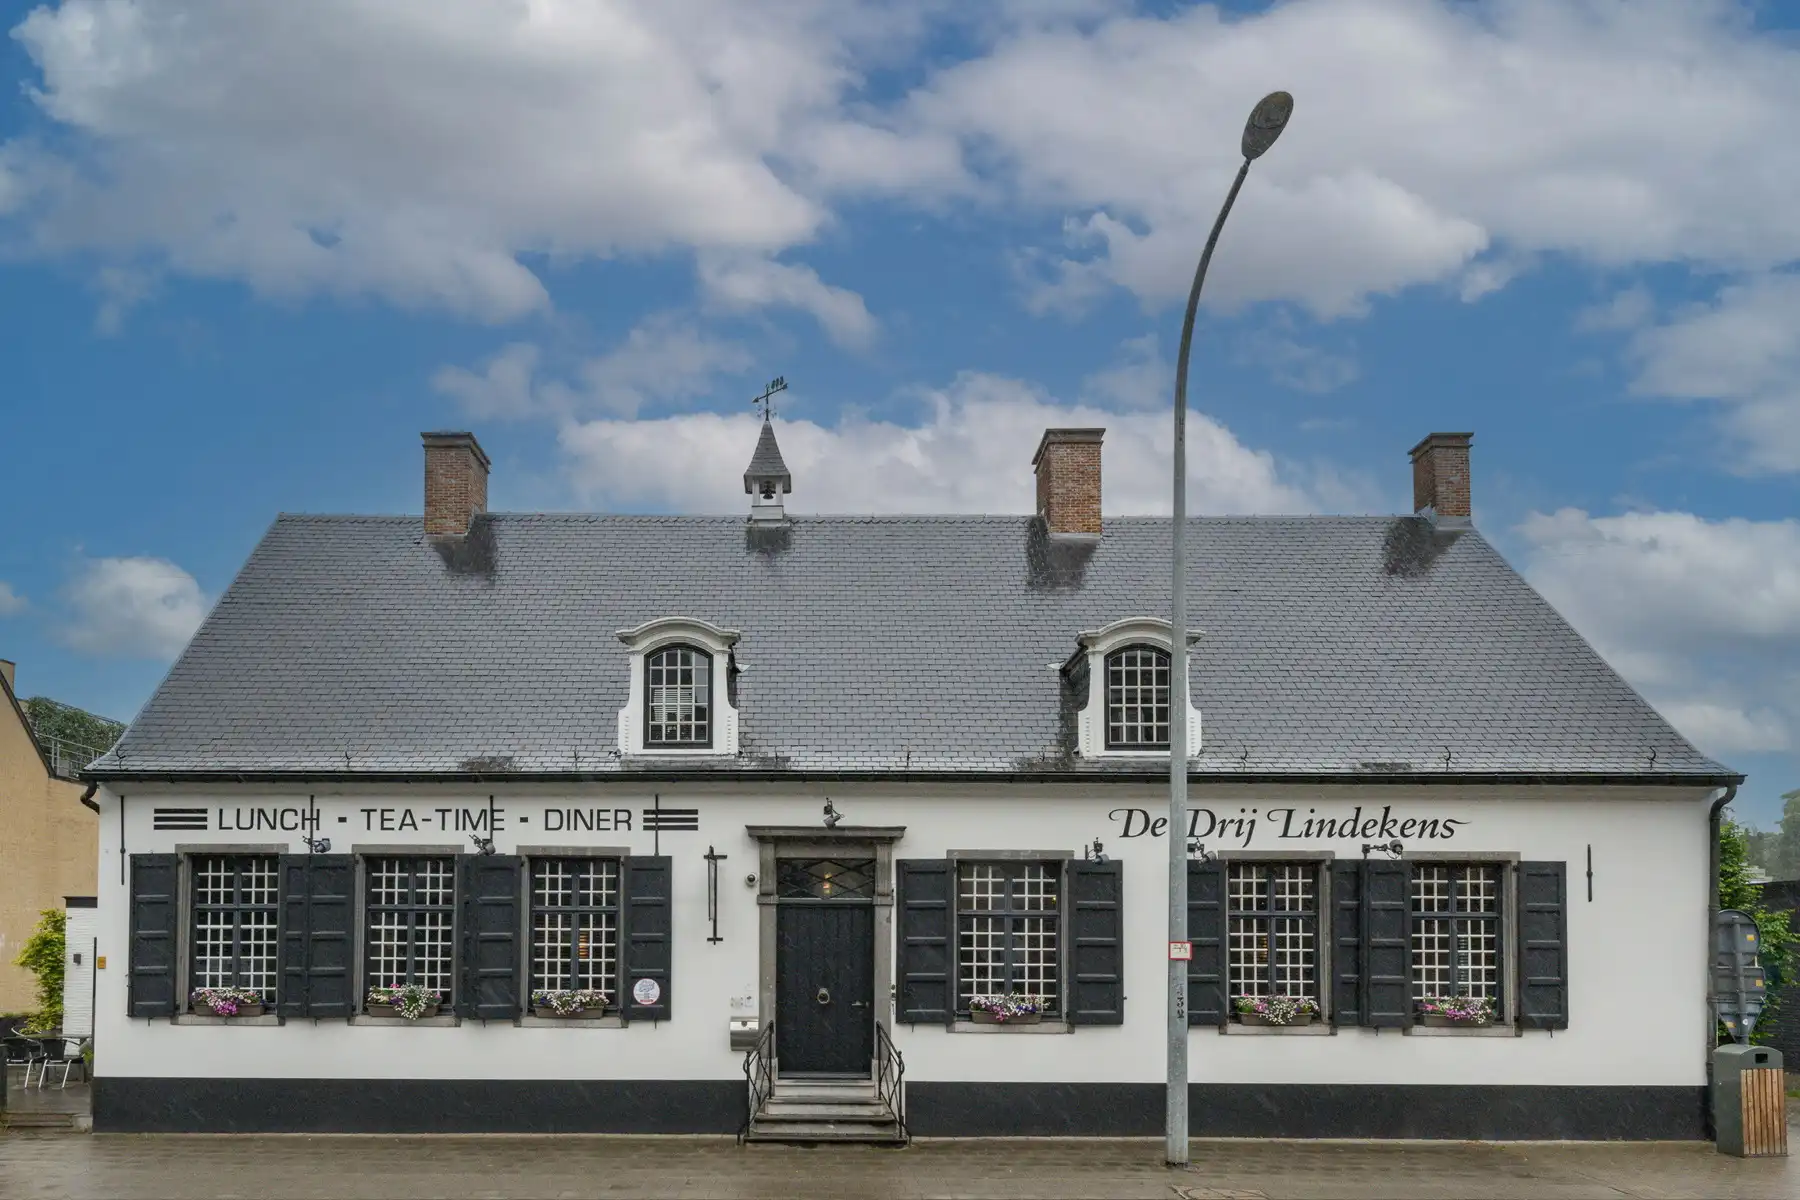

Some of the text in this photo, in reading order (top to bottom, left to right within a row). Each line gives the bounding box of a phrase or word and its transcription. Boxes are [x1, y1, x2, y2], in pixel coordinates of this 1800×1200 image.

[218, 808, 321, 831] LUNCH
[360, 808, 505, 831] TEA-TIME
[544, 808, 632, 831] DINER
[1108, 805, 1471, 848] De Drij Lindekens
